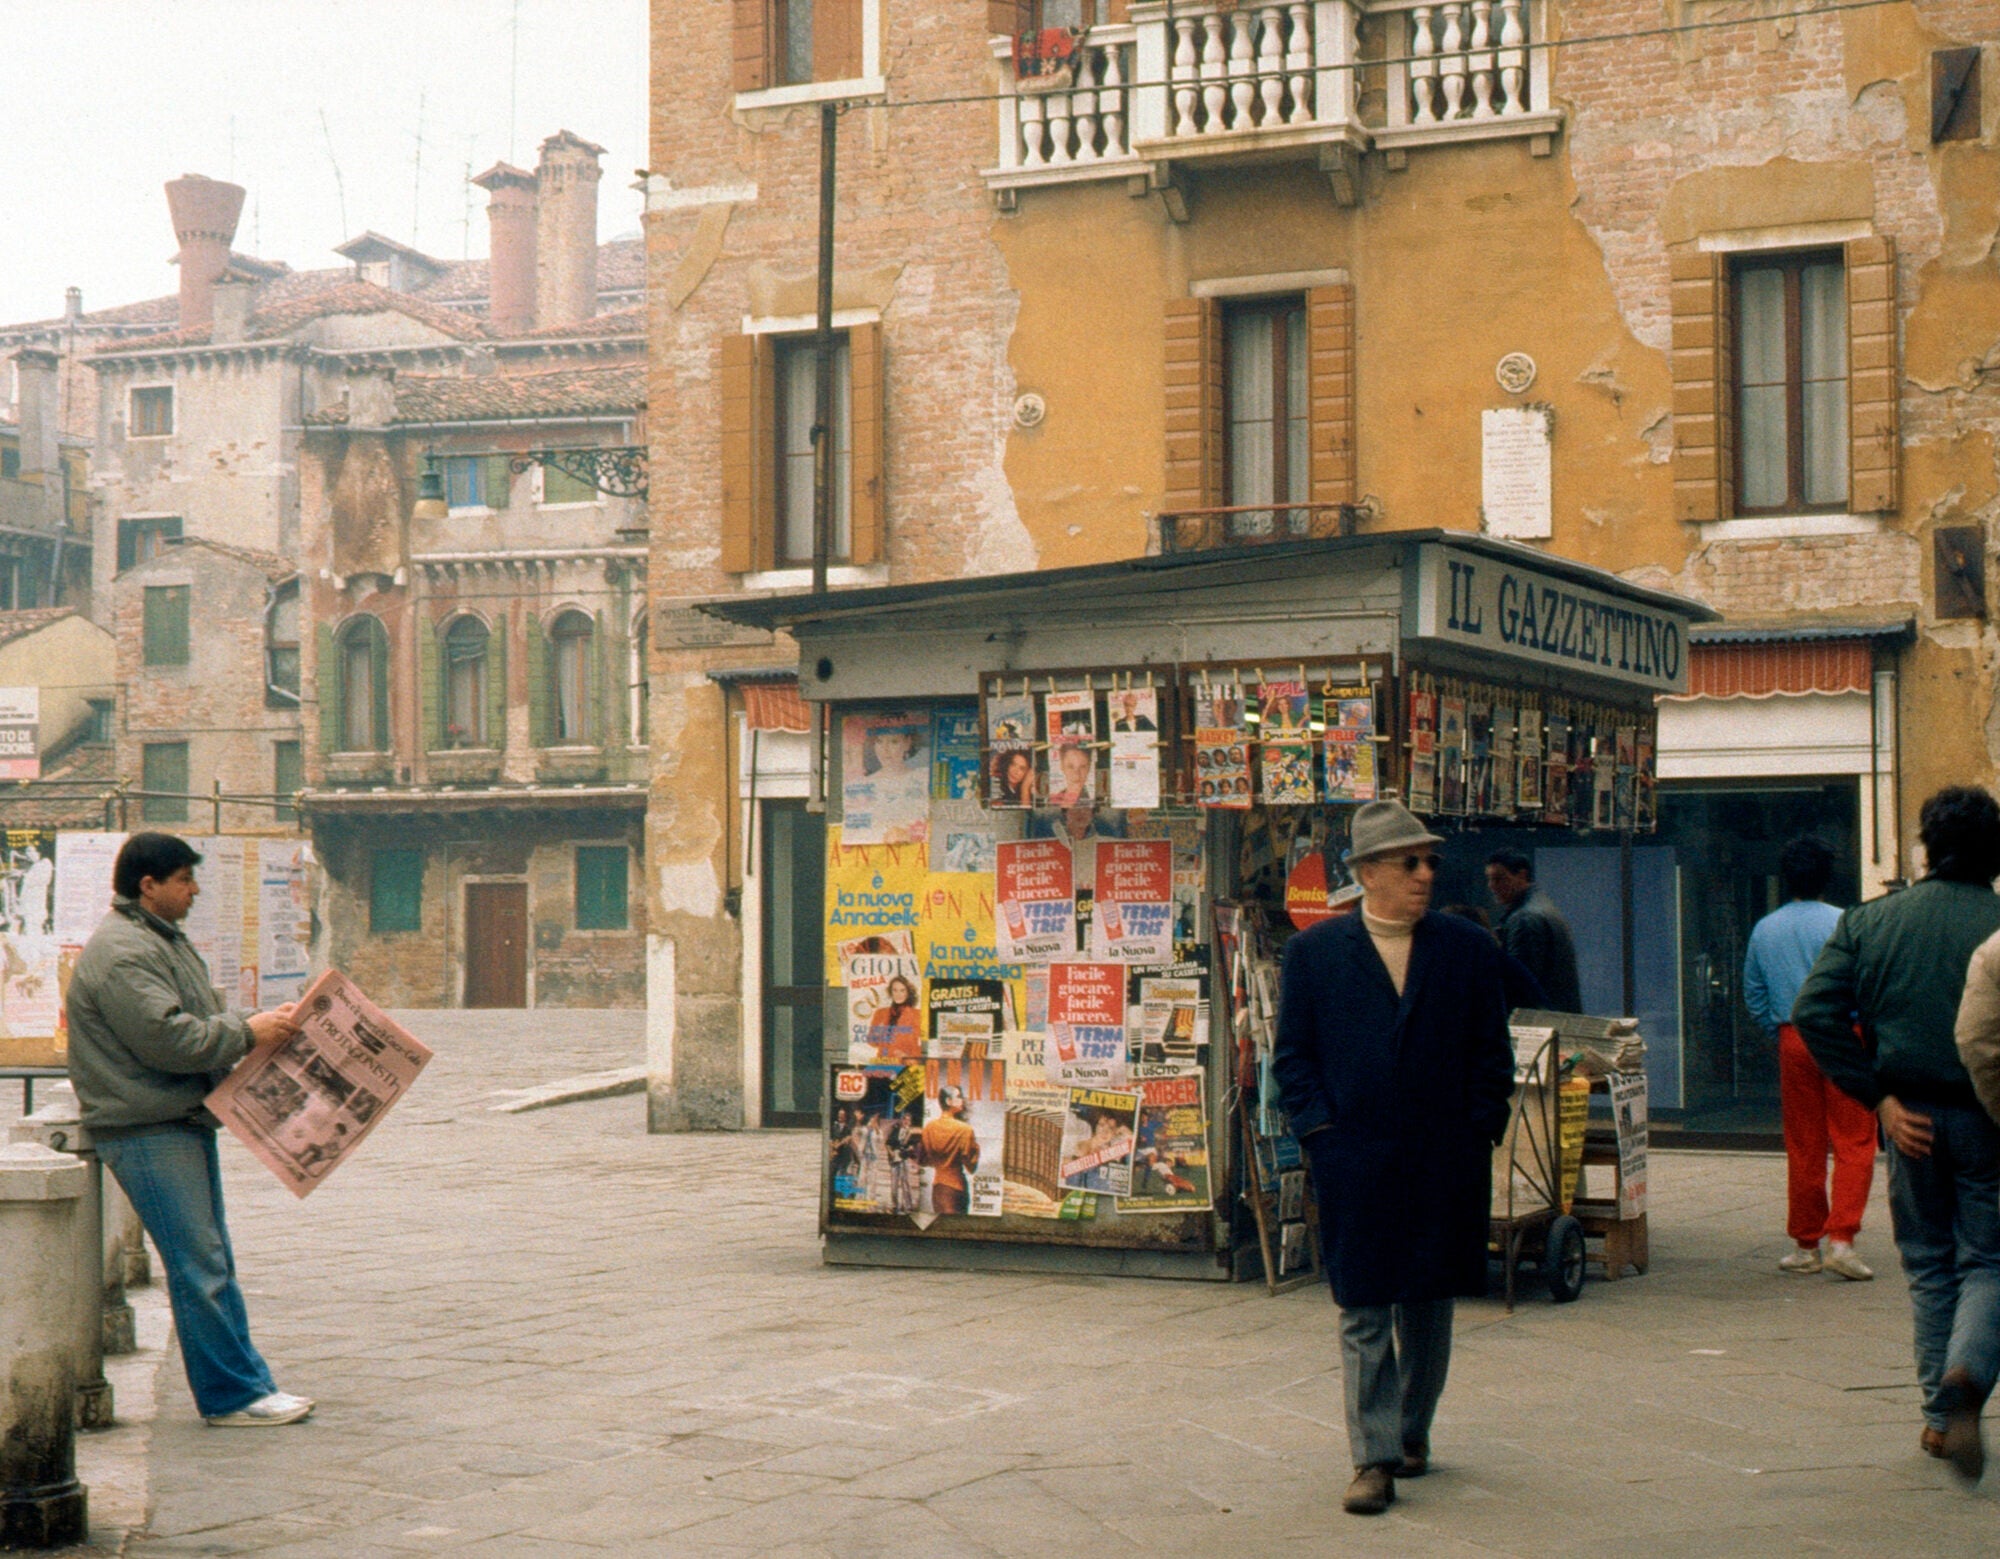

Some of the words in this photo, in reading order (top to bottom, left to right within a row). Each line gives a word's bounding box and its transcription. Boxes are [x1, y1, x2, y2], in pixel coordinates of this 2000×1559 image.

[1448, 561, 1482, 634] IL
[1498, 573, 1679, 680] GAZZETTINO
[1015, 844, 1055, 859] Facile
[1114, 845, 1153, 859] Facile
[871, 869, 884, 889] è
[1016, 872, 1053, 888] facile
[1114, 873, 1152, 889] facile
[838, 889, 855, 907] la
[858, 892, 914, 907] nuova
[921, 889, 995, 921] ANN
[963, 922, 977, 942] è
[1031, 918, 1066, 933] TRIS
[1128, 921, 1163, 936] TRIS
[930, 942, 947, 960] la
[951, 945, 999, 960] nuov
[1013, 945, 1024, 956] la
[1026, 942, 1061, 956] Nuova
[1108, 946, 1119, 957] la
[1121, 944, 1156, 956] Nuova
[851, 958, 918, 976] GIOIA
[1066, 966, 1106, 981] Facile
[1133, 967, 1145, 975] UN
[1161, 970, 1171, 978] SU
[1173, 966, 1208, 978] CASSETTA
[930, 985, 979, 1001] GRATIS!
[930, 1000, 942, 1009] UN
[943, 996, 992, 1007] PROGRAMMA
[1067, 995, 1105, 1011] facile
[1081, 1043, 1116, 1058] TRIS
[1062, 1068, 1072, 1079] la
[1074, 1067, 1109, 1078] Nuova
[1143, 1064, 1180, 1076] USCITO
[839, 1074, 863, 1092] RC
